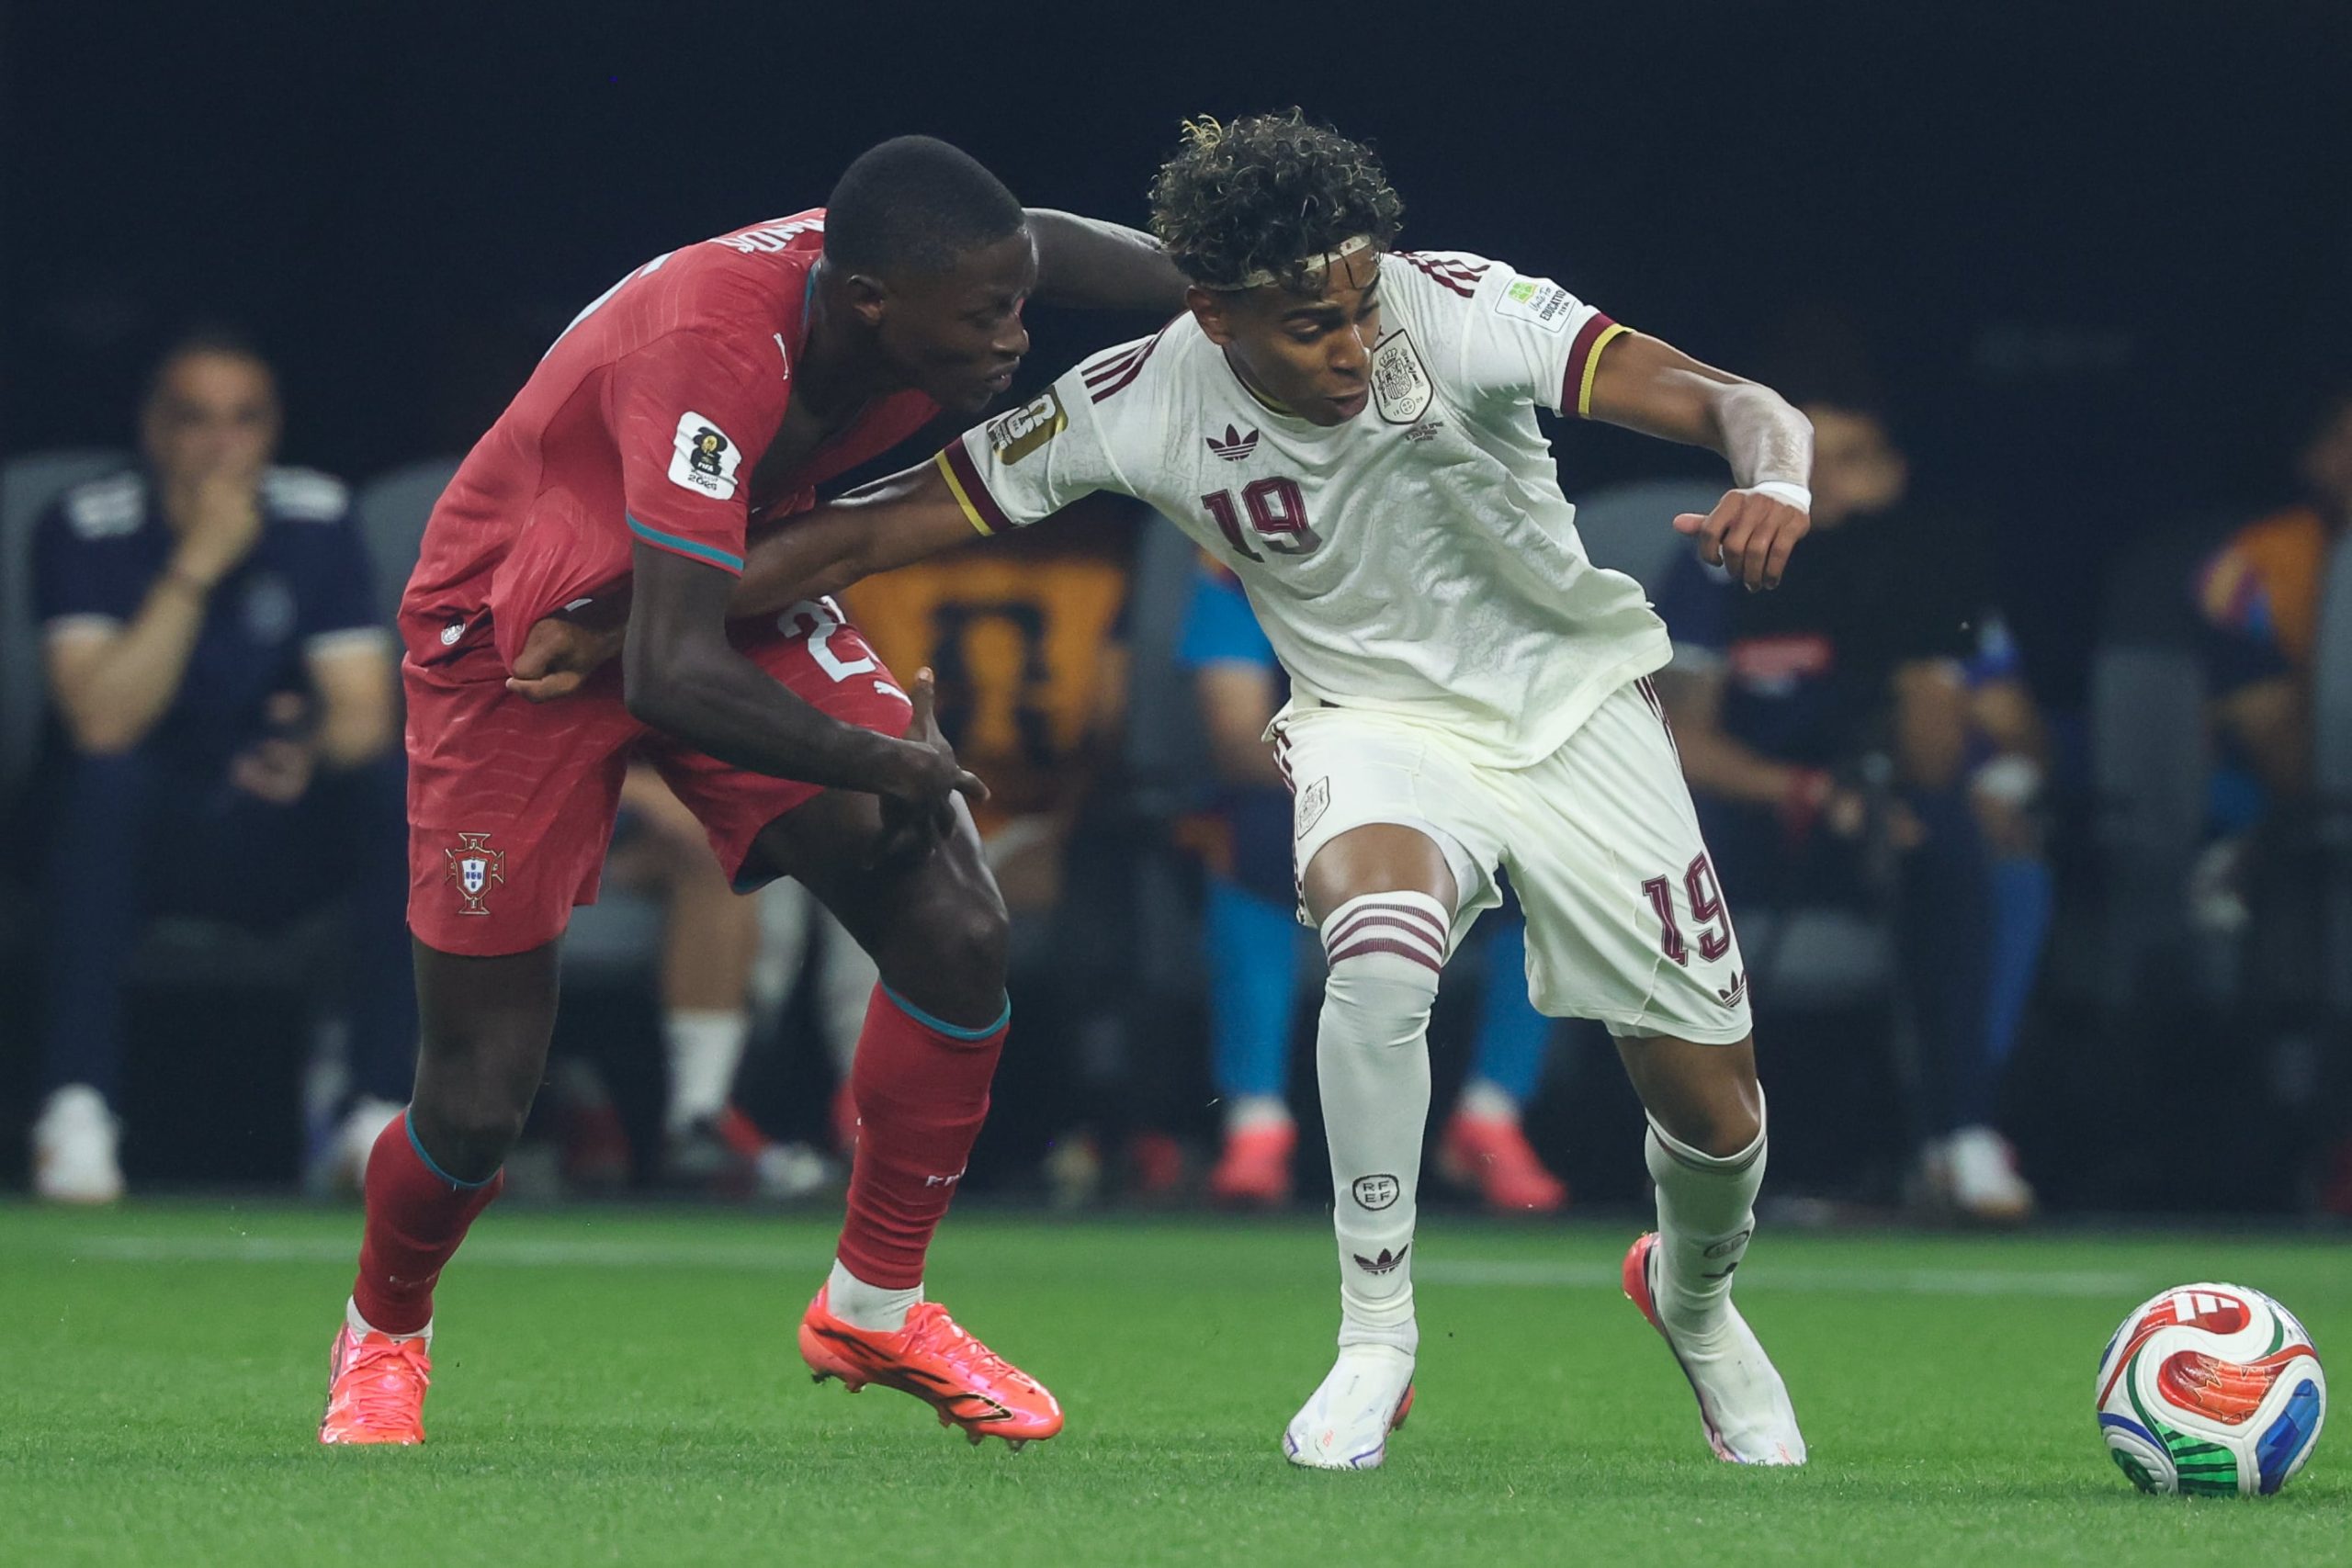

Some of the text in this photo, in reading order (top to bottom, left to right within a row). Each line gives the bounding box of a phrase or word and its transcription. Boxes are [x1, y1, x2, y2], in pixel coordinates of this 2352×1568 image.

[1539, 289, 1566, 321] EDUCATIO
[1201, 476, 1323, 563] 19
[777, 595, 882, 682] 2
[1641, 851, 1730, 967] 19
